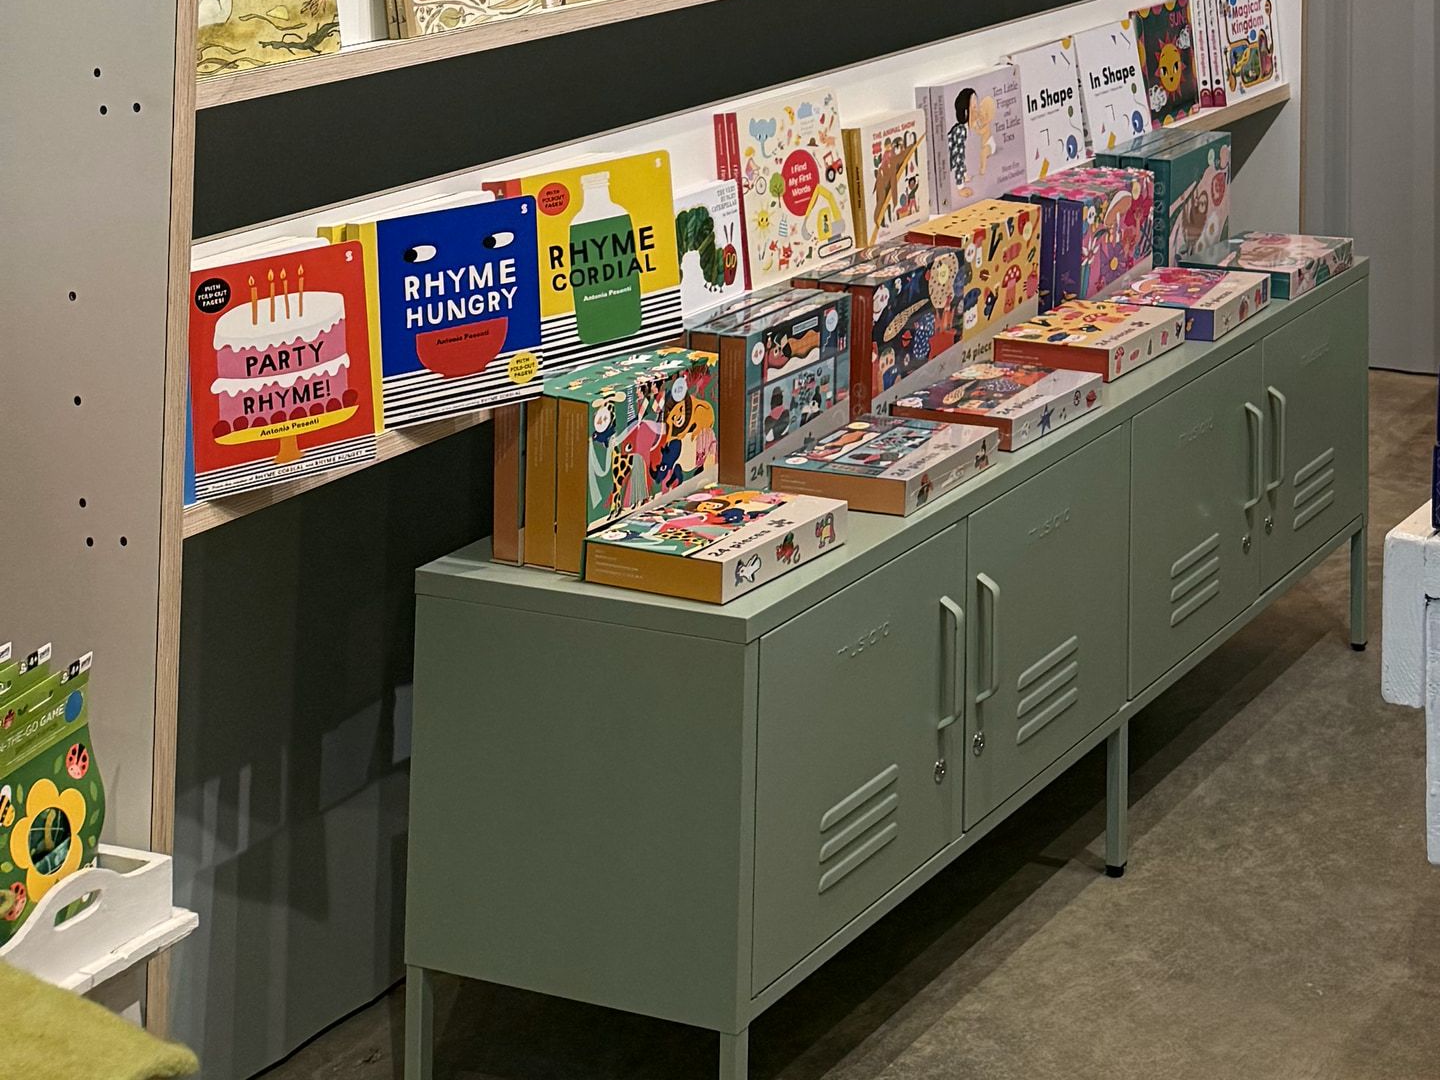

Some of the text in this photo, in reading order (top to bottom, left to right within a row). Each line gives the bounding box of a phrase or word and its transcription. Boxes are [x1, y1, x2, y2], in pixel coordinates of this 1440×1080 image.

[1231, 15, 1264, 37] Kingdom
[1089, 64, 1136, 90] In Shape
[1003, 81, 1018, 94] Little
[1027, 85, 1073, 114] In Shape
[873, 121, 916, 140] THE ANIMAL SHOW
[1006, 118, 1021, 131] Little
[795, 162, 807, 174] Find
[788, 173, 812, 187] My First
[792, 186, 811, 196] Words
[549, 225, 655, 270] RHYME
[403, 258, 517, 301] RHYME
[551, 253, 657, 292] CORDIAL
[583, 285, 632, 302] Antonia Pesenti
[405, 287, 519, 329] HUNGRY
[246, 340, 325, 376] PARTY
[961, 350, 972, 362] 24
[243, 379, 332, 415] RHYME!
[876, 404, 888, 415] 24
[260, 418, 320, 438] Antonia Pesenti
[751, 464, 765, 480] 24
[707, 528, 771, 557] 24 pieces
